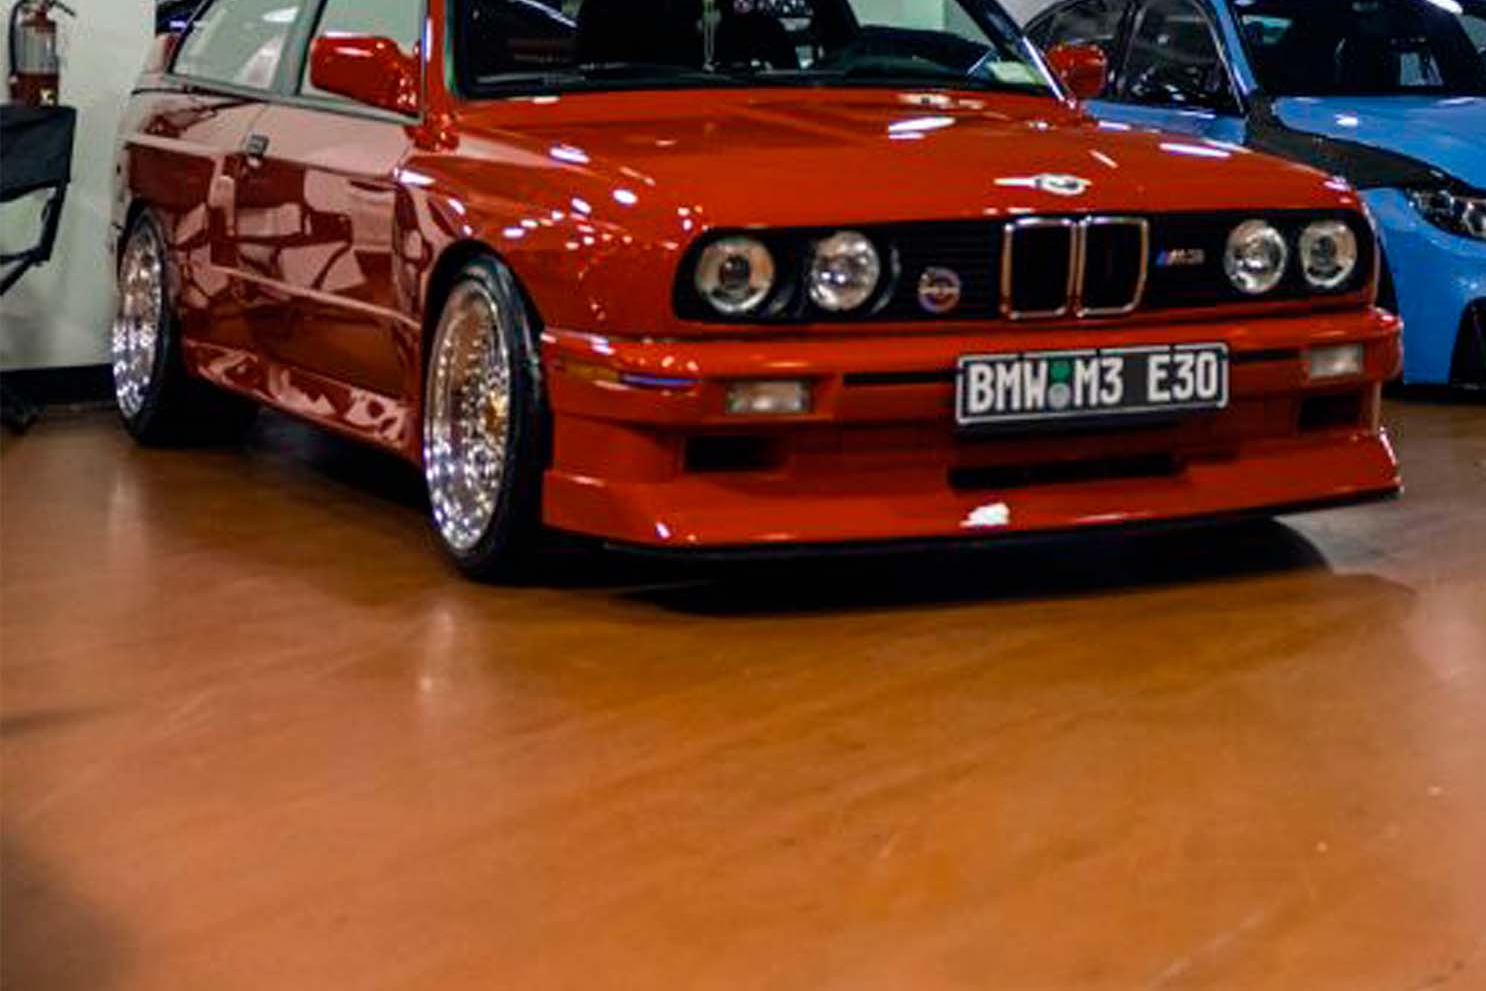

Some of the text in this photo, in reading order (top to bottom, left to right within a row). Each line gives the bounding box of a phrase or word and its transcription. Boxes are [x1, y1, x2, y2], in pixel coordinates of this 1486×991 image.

[967, 352, 1218, 413] BMW M3 E30
